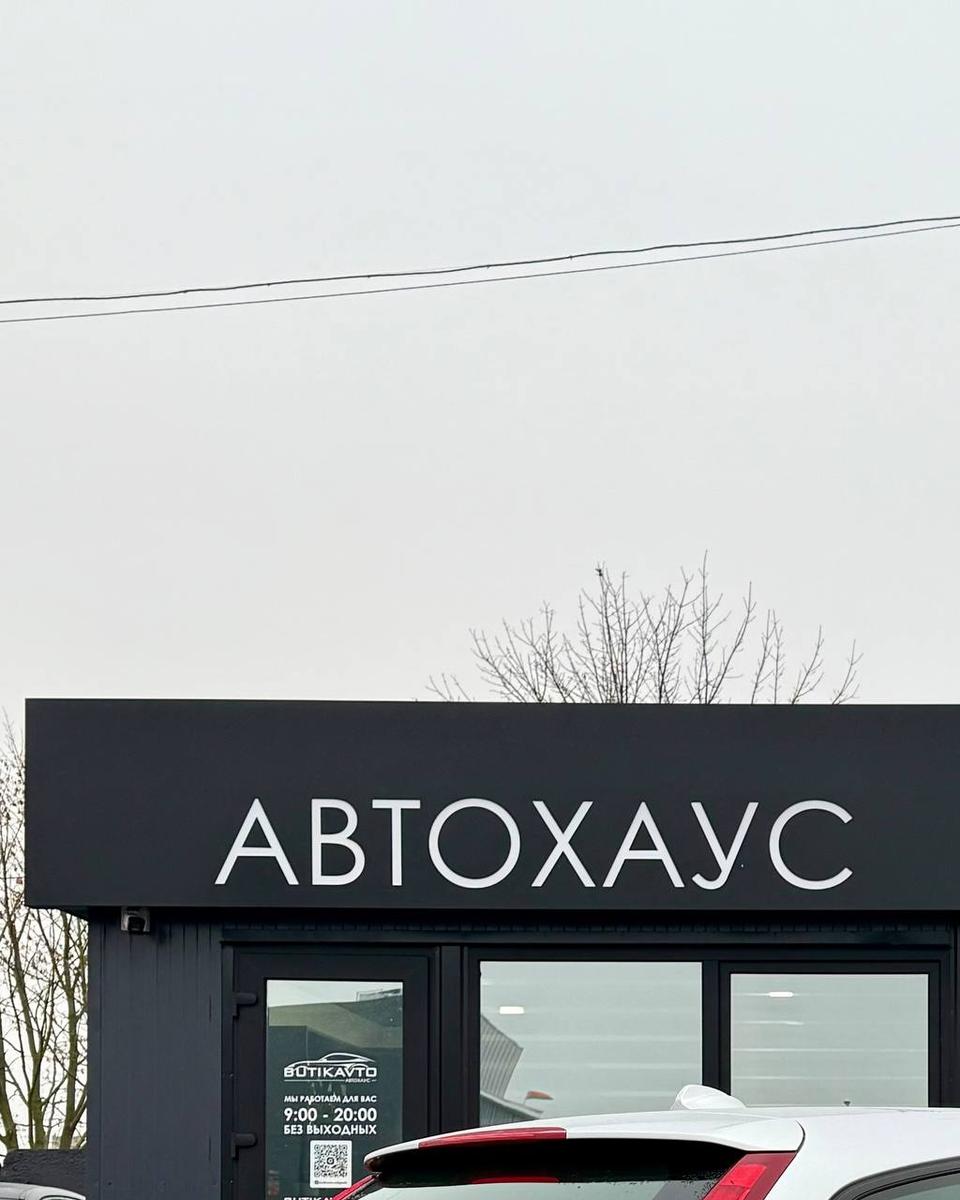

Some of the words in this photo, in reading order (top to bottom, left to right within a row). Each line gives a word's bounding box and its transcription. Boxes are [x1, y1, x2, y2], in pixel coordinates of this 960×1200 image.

[215, 798, 853, 890] АВТОХАУС
[284, 1067, 377, 1077] BUTIKAVTO
[284, 1107, 317, 1121] 9:00
[333, 1107, 377, 1121] 20:00
[284, 1124, 303, 1135] БЕЗ
[306, 1124, 377, 1136] ВЫХОДНЫХ
